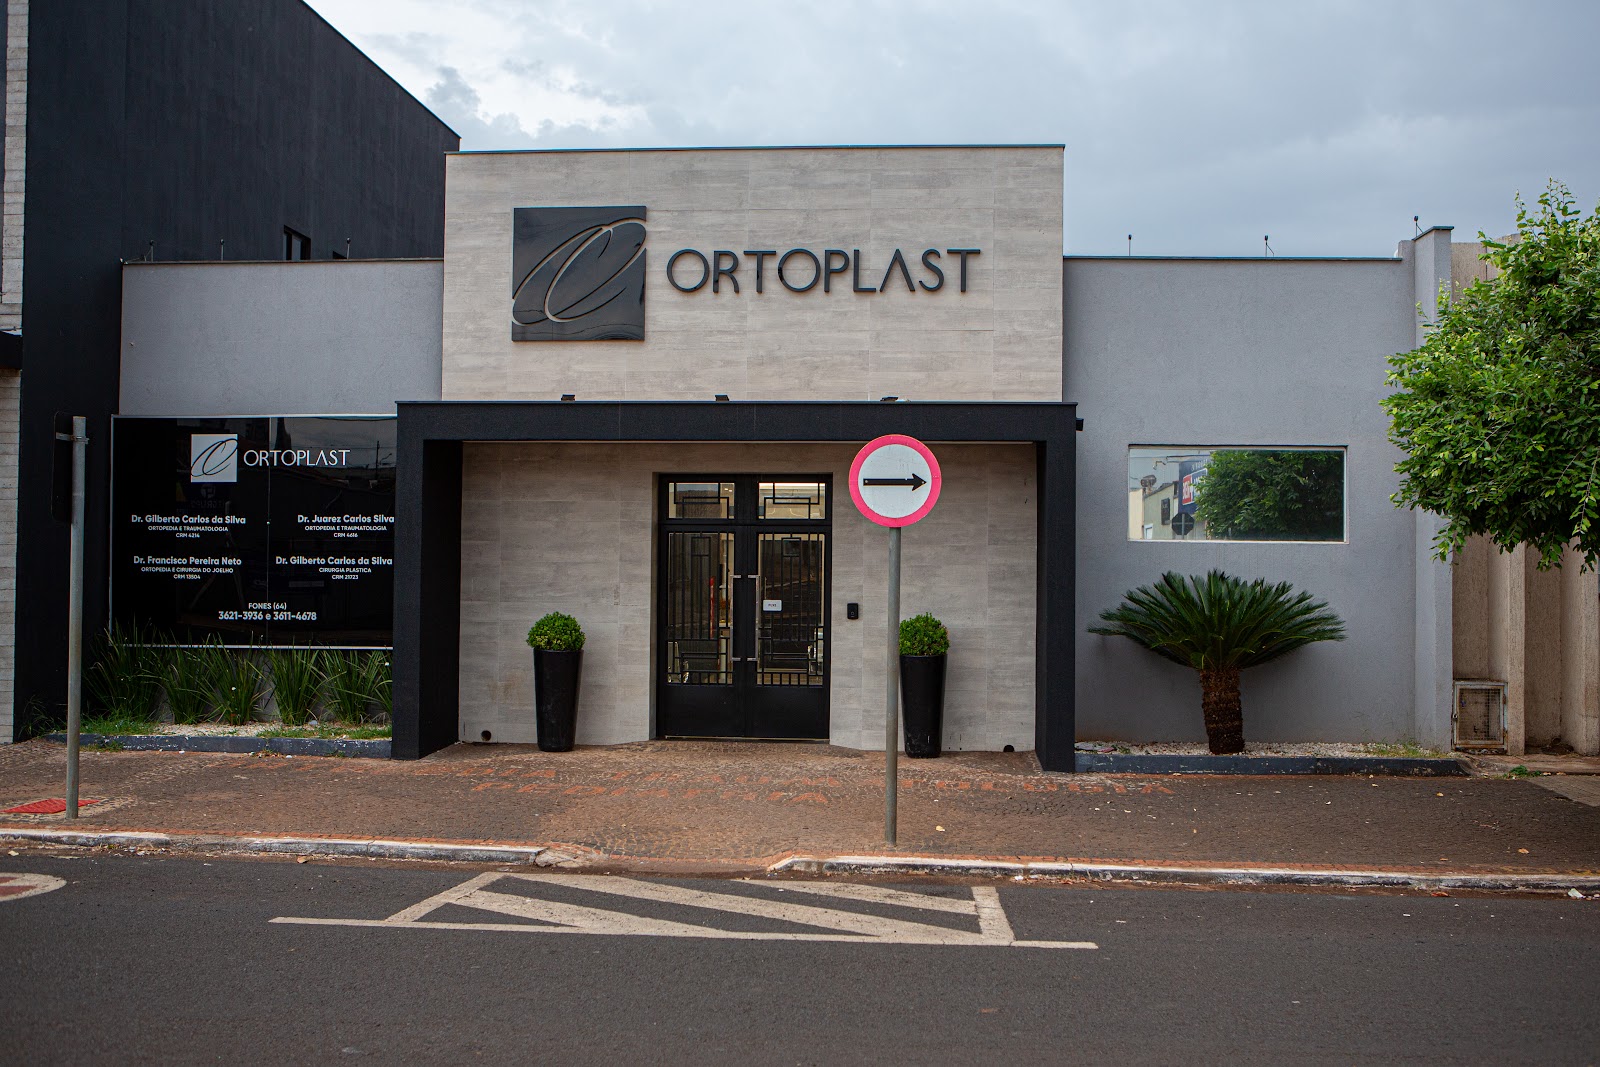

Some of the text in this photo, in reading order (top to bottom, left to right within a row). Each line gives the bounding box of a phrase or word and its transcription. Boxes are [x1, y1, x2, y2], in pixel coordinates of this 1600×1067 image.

[667, 248, 981, 294] ORTOPLAST
[243, 449, 351, 467] ORTOPLAST
[131, 514, 247, 525] Dr. Gilberto Carlos da Silva
[297, 514, 394, 524] Dr. Juarez Carlos Silva
[133, 555, 242, 566] Dr. Francisco Pereira Neto
[275, 555, 393, 566] Dr. Gilberto Carlos da Silva
[248, 601, 287, 611] FONES (64)
[218, 610, 318, 621] 3621-3936 e 3611-4678
